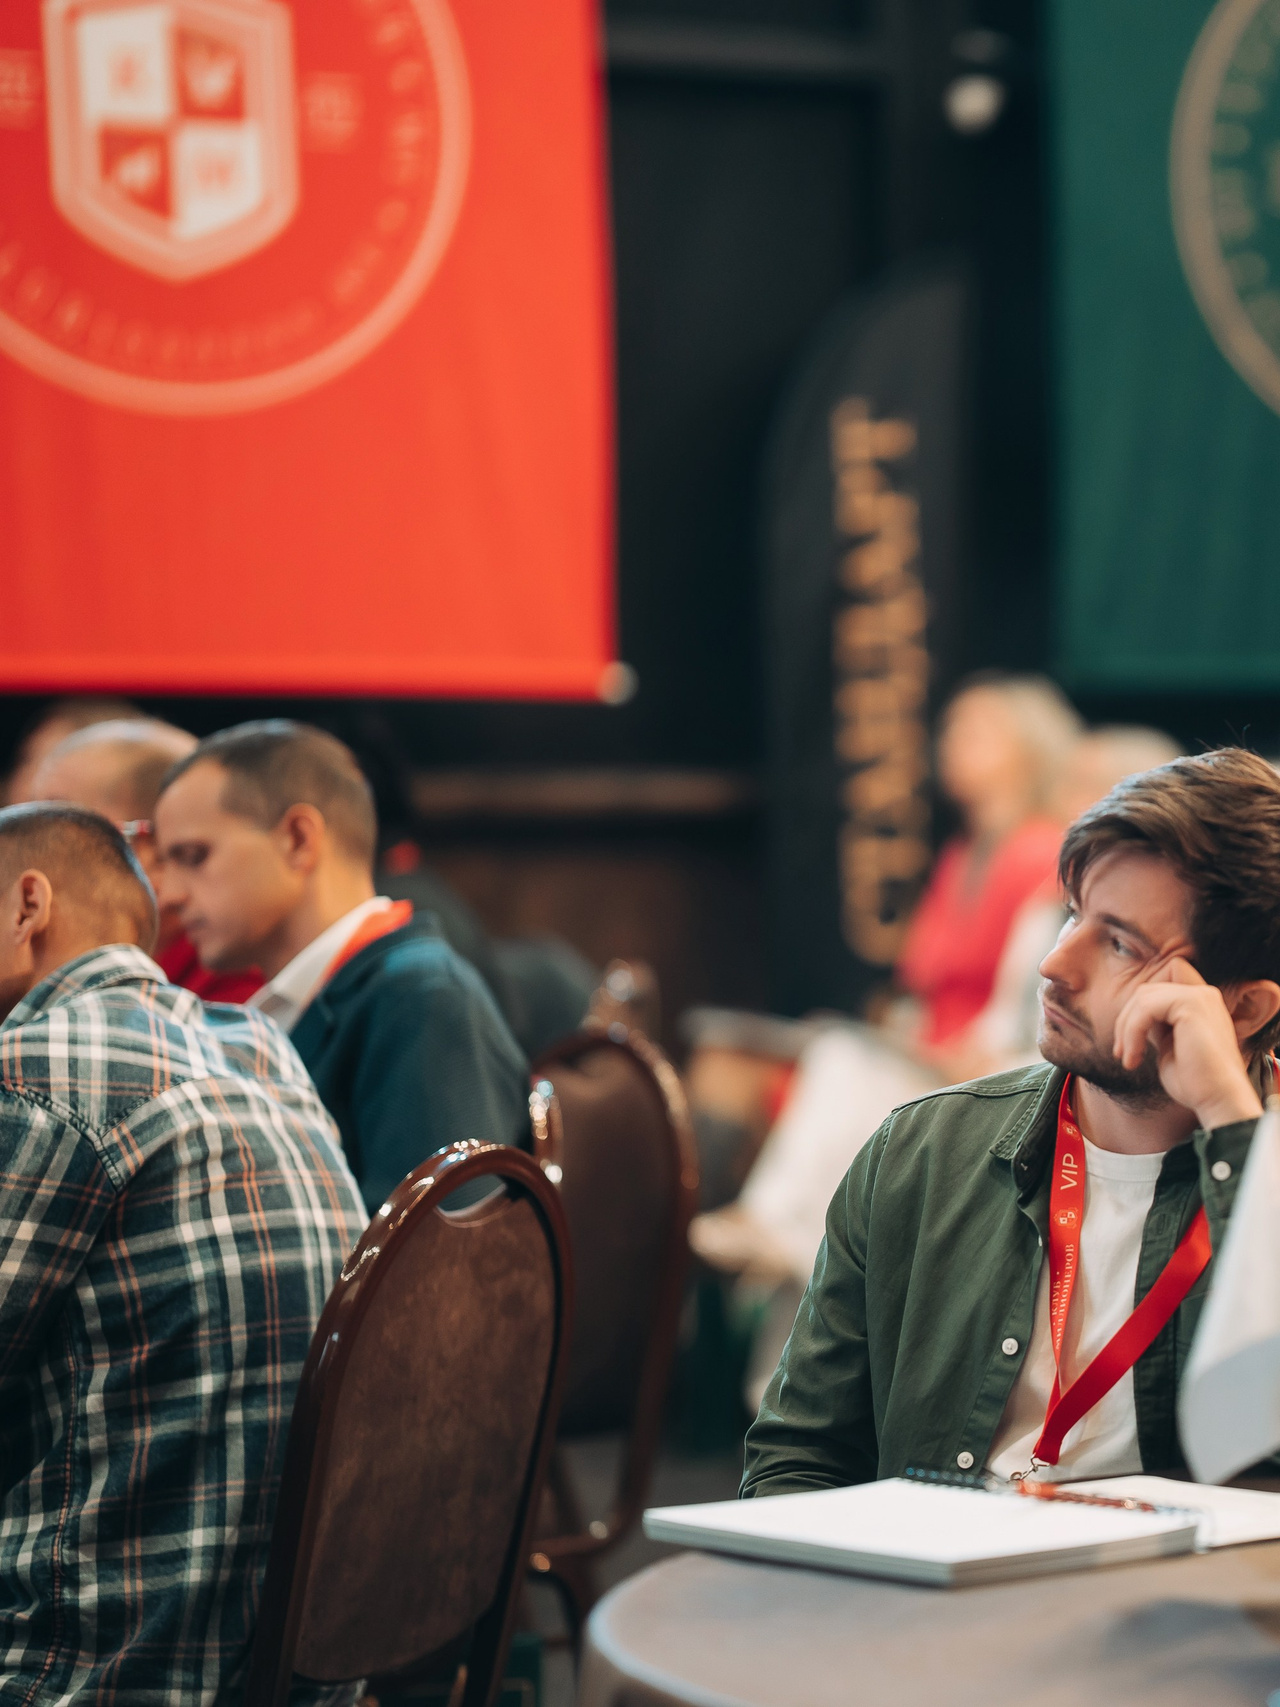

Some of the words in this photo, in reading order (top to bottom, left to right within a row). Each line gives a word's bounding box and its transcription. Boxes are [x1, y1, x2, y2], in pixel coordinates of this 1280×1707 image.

[1060, 1153, 1078, 1190] VIP
[1052, 1281, 1061, 1316] КЛУБ
[1056, 1243, 1074, 1350] МИЛЛИОНЕРОВ
